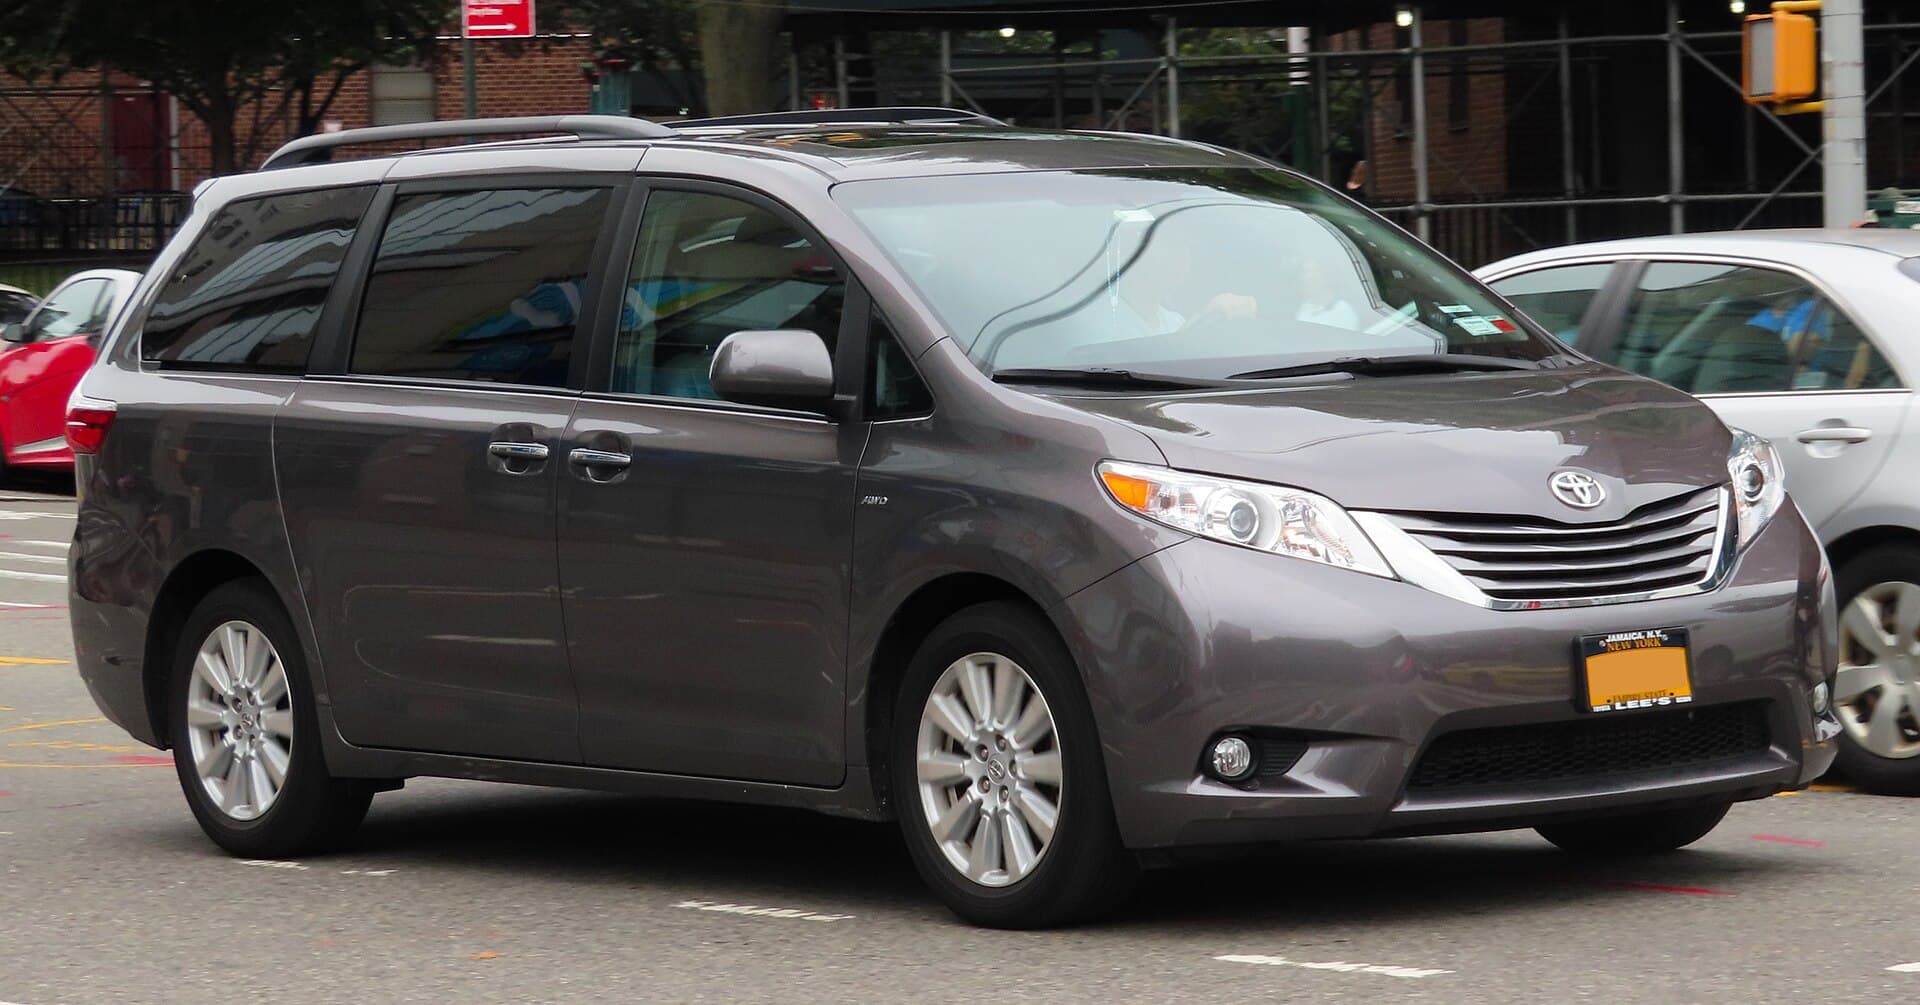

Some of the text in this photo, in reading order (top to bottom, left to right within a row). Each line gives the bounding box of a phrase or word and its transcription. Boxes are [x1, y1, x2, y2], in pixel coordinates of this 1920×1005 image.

[861, 495, 888, 504] AWD
[1607, 638, 1662, 652] NEW YORK
[1615, 696, 1671, 710] LEE'S
